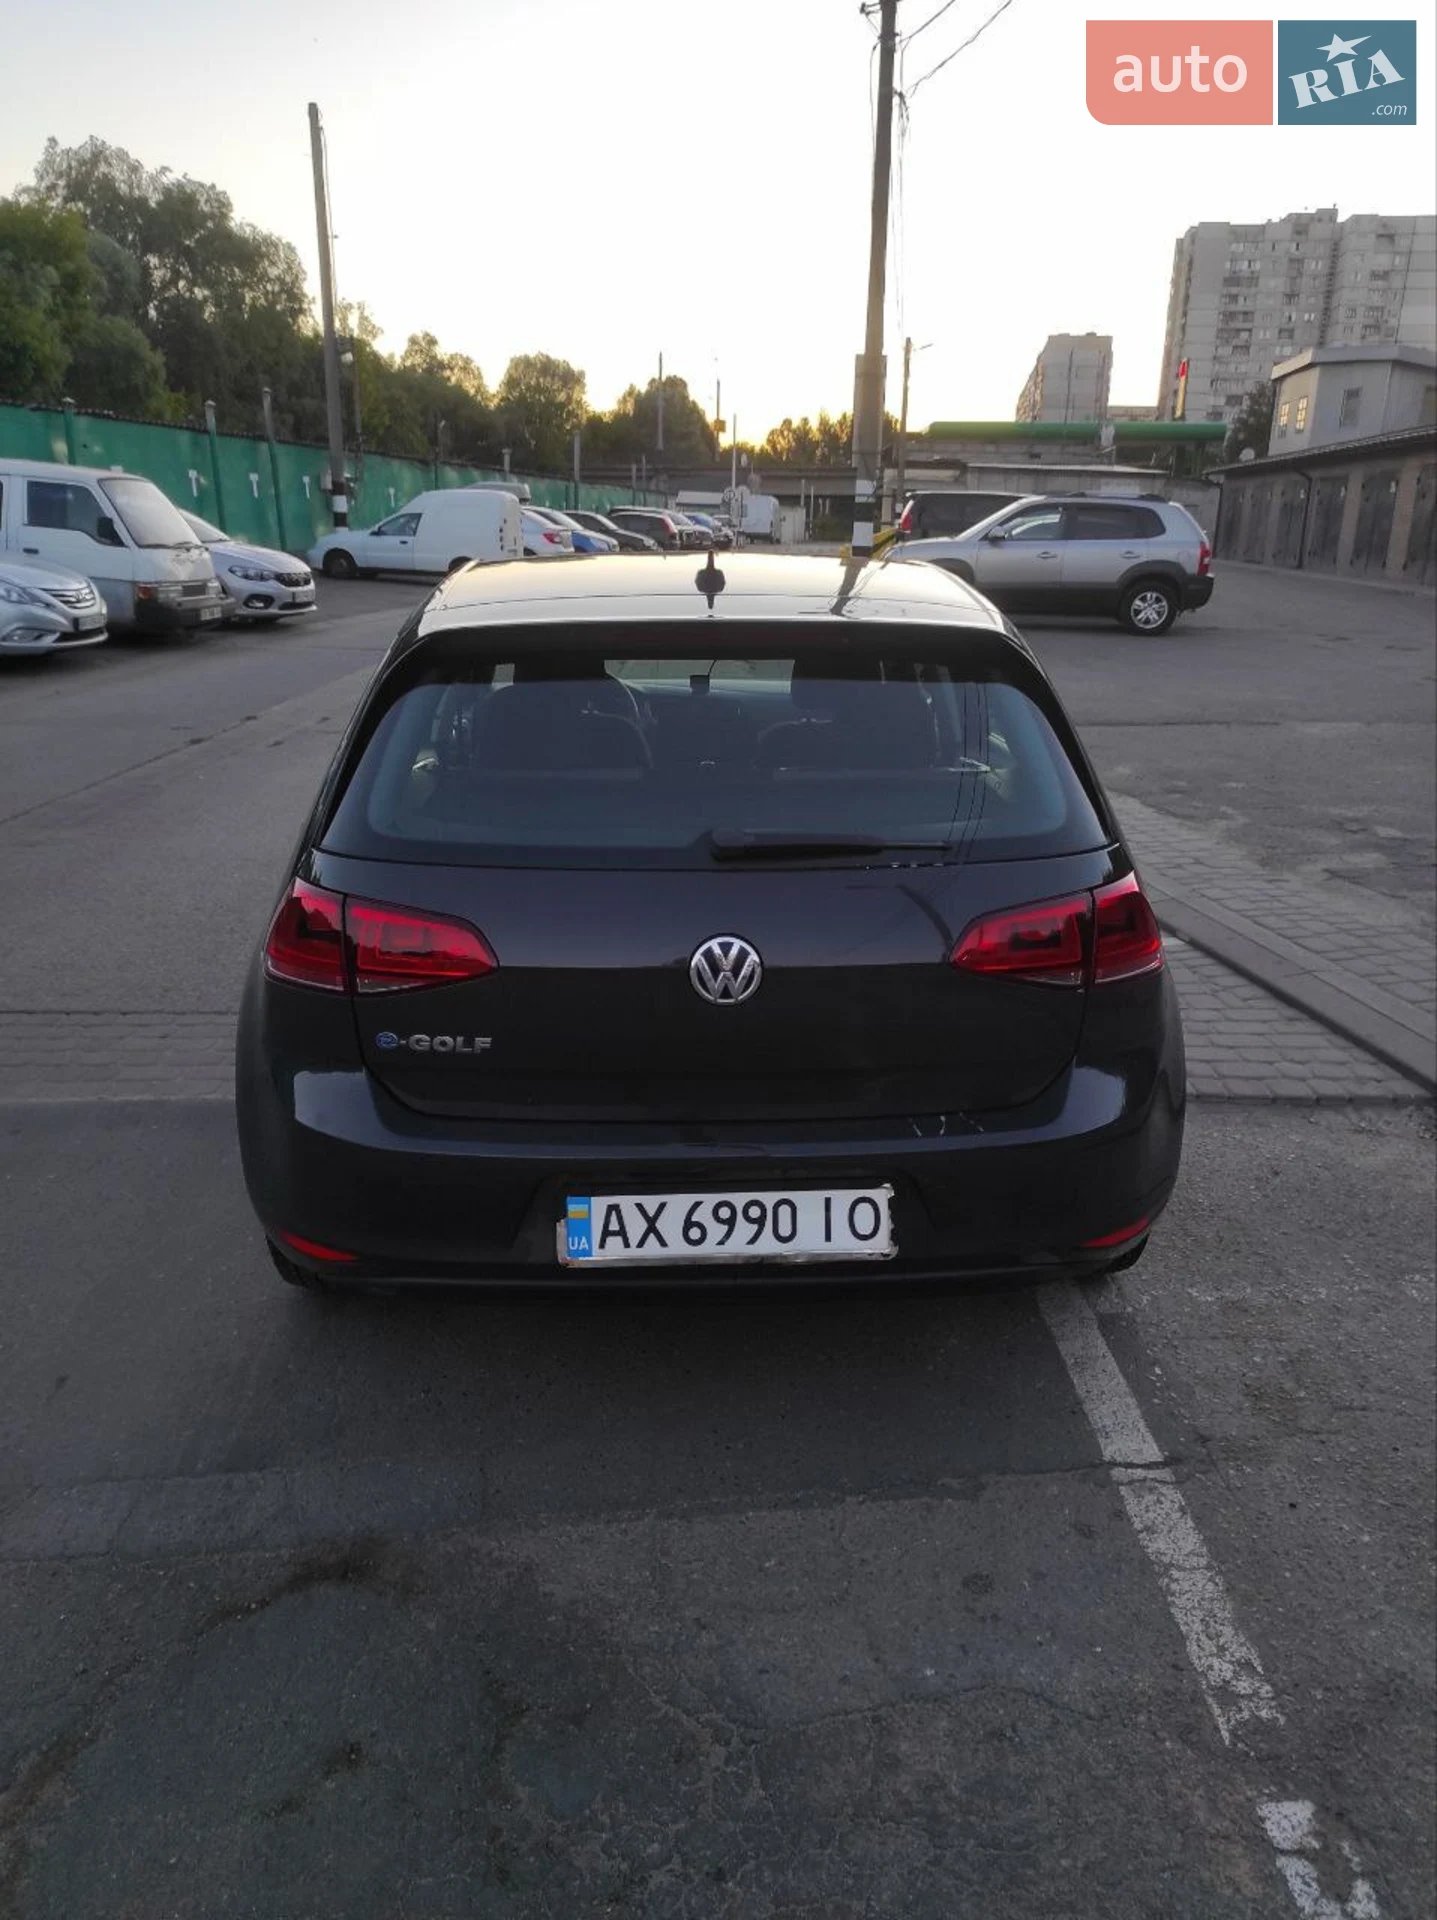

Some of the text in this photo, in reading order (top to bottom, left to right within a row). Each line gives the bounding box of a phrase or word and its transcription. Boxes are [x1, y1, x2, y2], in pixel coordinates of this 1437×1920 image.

[598, 1201, 669, 1250] AX
[682, 1198, 798, 1247] 6990
[568, 1236, 589, 1251] UA
